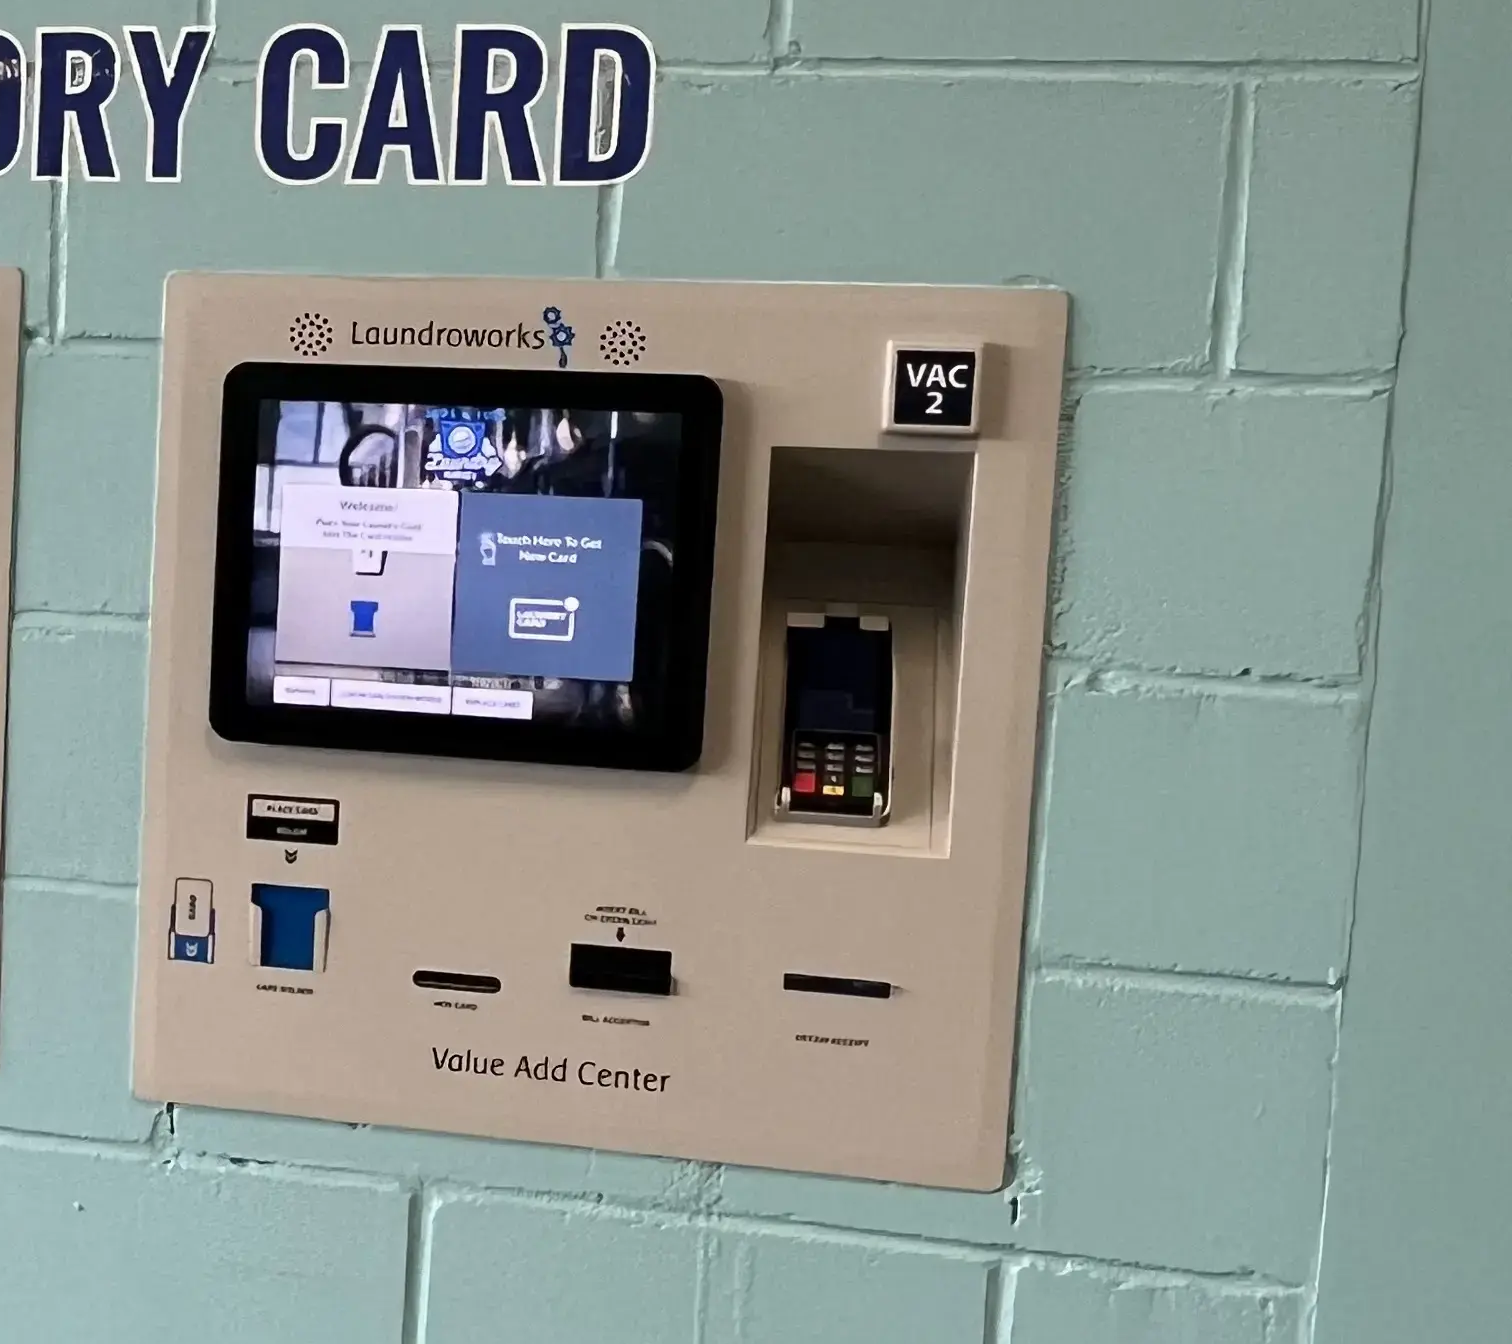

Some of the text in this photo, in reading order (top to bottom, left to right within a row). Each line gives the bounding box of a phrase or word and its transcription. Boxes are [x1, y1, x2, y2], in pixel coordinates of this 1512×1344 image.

[255, 22, 658, 187] CARD
[350, 319, 546, 351] Laundroworks
[906, 362, 969, 389] VAC
[924, 391, 944, 415] 2
[431, 1046, 672, 1093] Value Add Center
